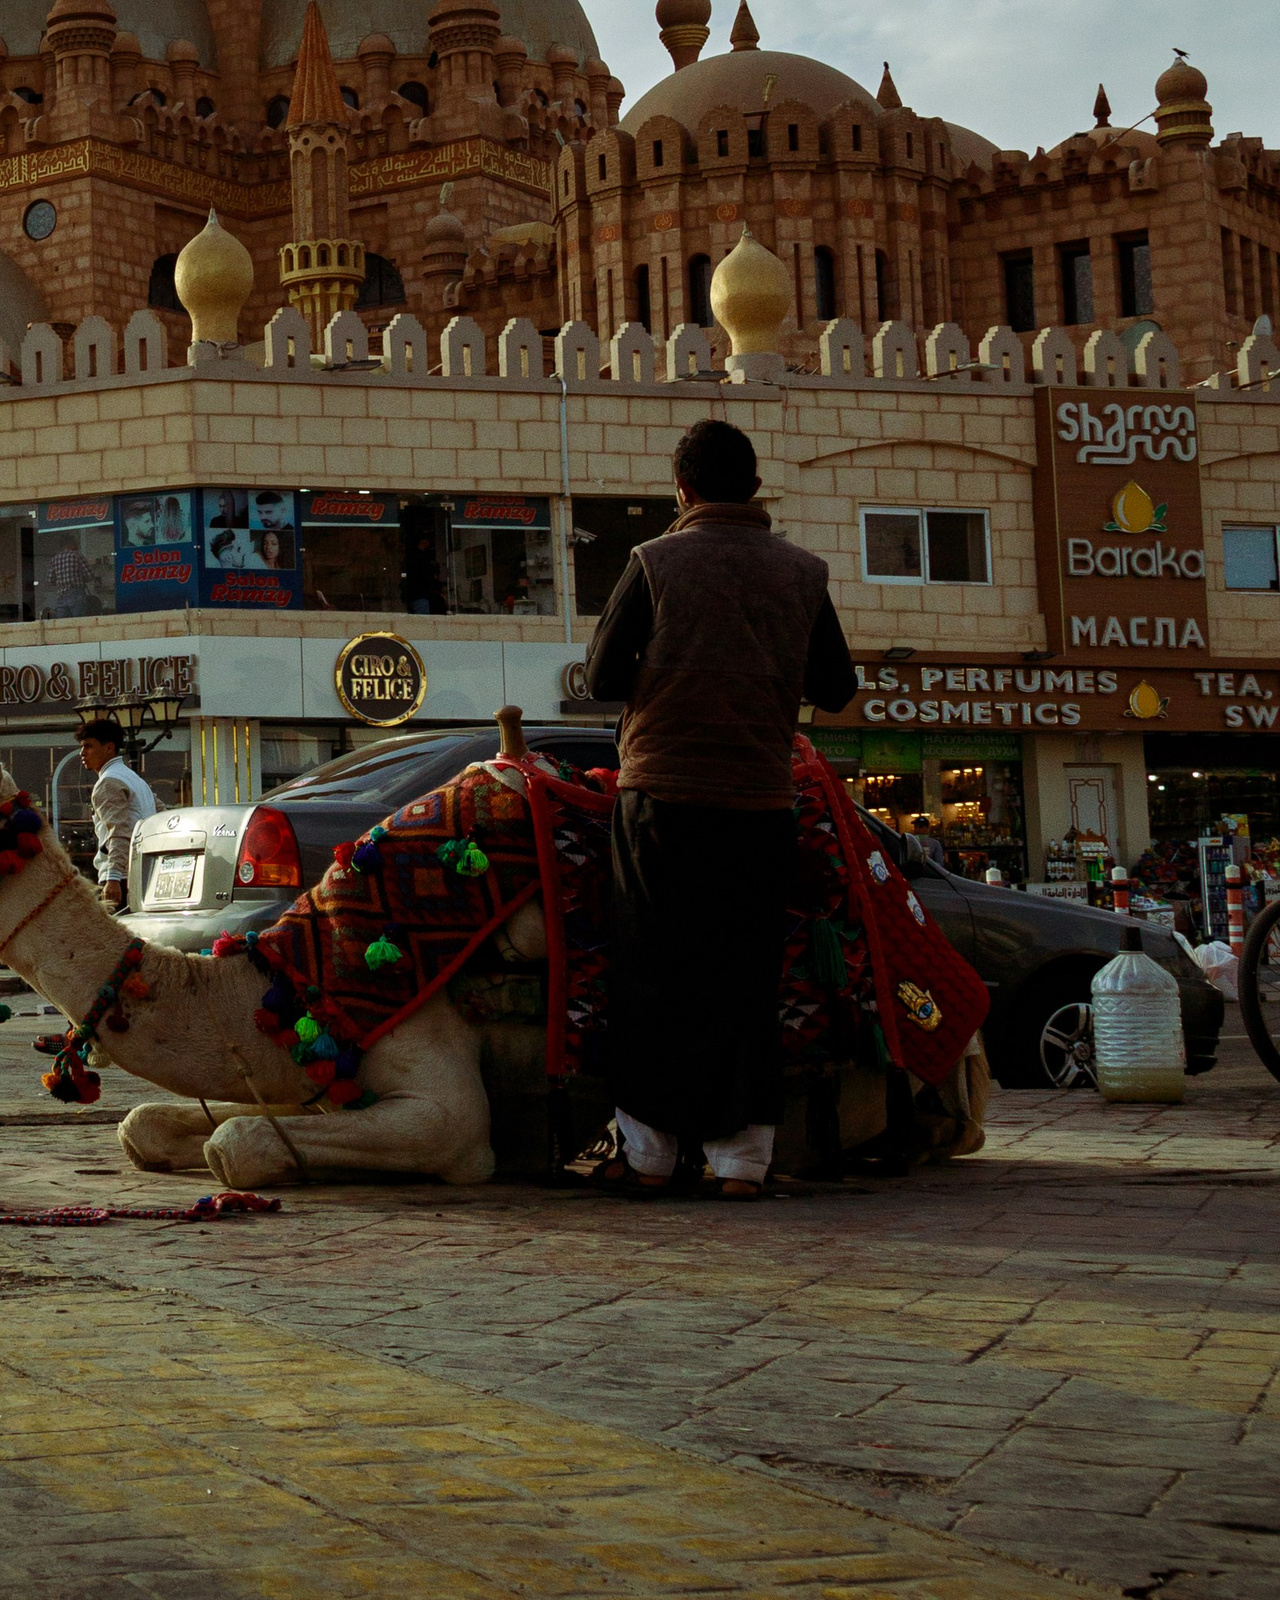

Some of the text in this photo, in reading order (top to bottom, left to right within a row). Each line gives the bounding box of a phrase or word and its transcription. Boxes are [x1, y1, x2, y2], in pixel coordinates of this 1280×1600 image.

[46, 501, 109, 521] Ramzy
[310, 498, 385, 520] Ramzy
[463, 500, 537, 524] Ramzy
[133, 548, 181, 564] Salon
[1067, 538, 1206, 578] Baraka
[121, 563, 193, 584] Ramzy
[225, 572, 280, 588] Salon
[210, 584, 293, 607] Ramzy
[1070, 614, 1207, 648] МАСЛА
[46, 661, 72, 701] &
[77, 654, 196, 701] FELICE
[350, 654, 414, 700] CIRO & FELICE
[921, 667, 1118, 694] PERFUMES
[1194, 672, 1273, 700] TEA,
[863, 699, 1081, 725] COSMETICS
